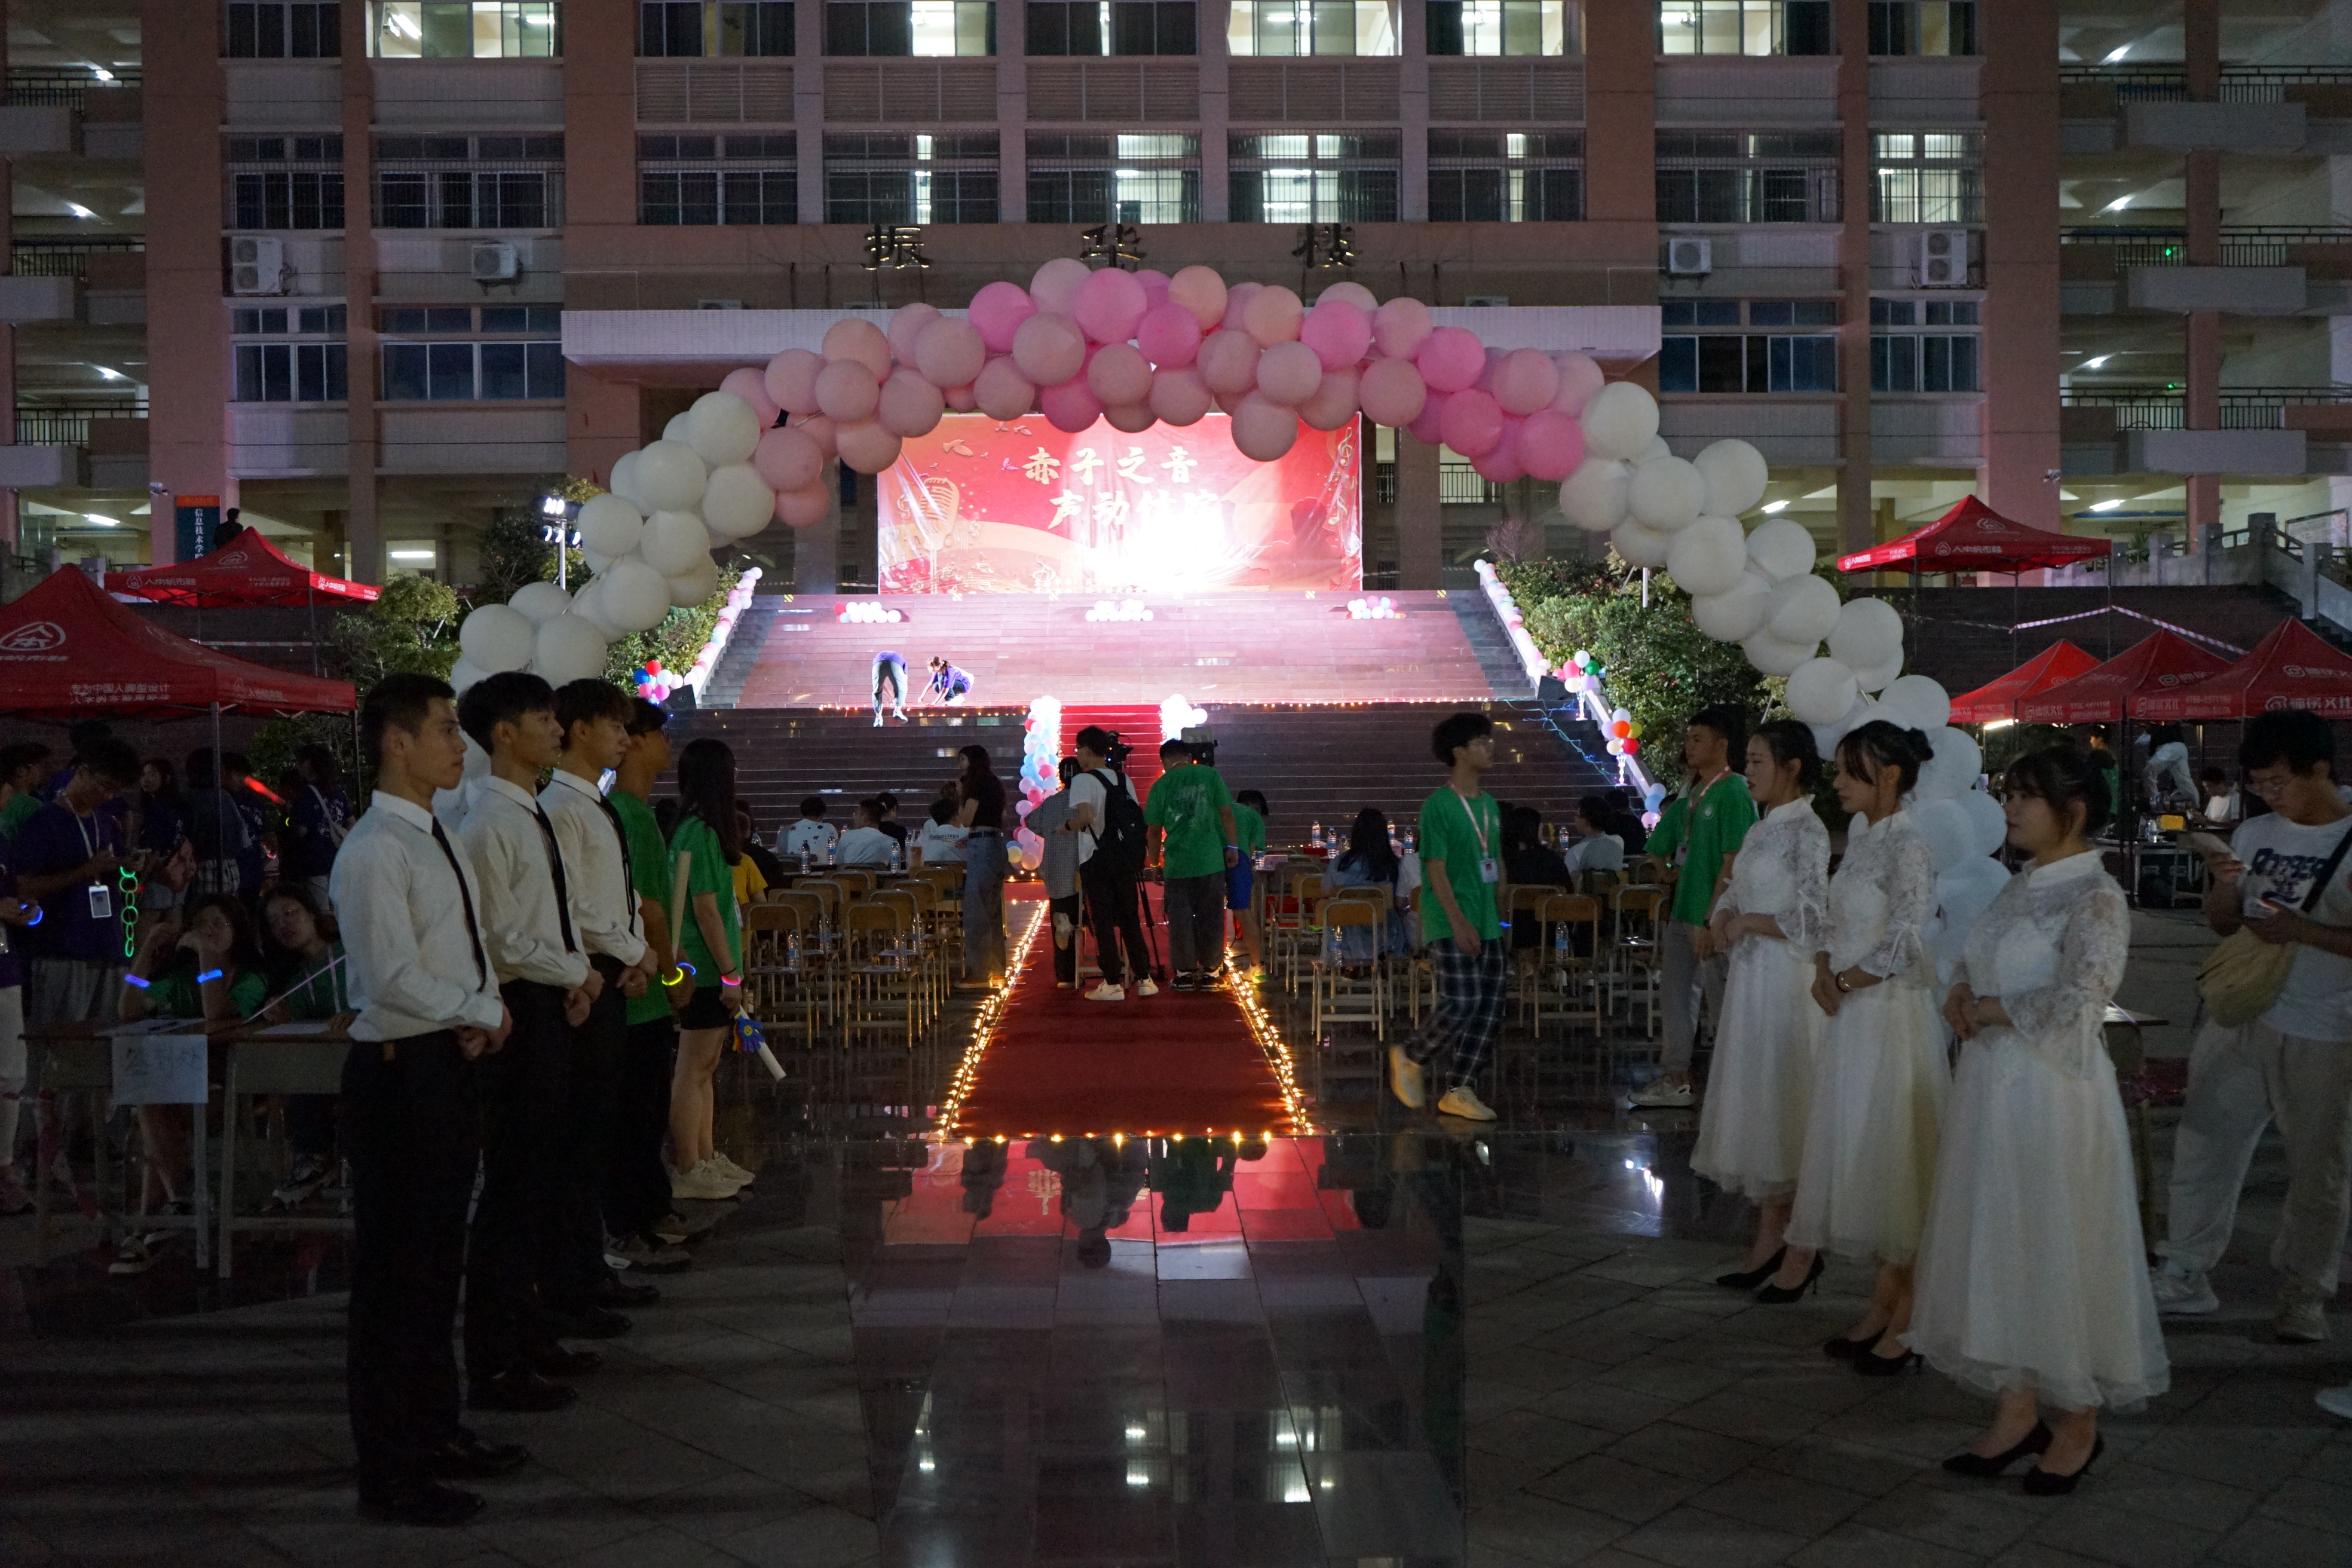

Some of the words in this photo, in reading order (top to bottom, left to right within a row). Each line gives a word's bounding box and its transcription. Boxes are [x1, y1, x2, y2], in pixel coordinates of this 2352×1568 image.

[860, 222, 1364, 270] 振华楼
[1022, 445, 1198, 486] 赤子之音
[71, 682, 170, 694] 专为中国人脚型设计
